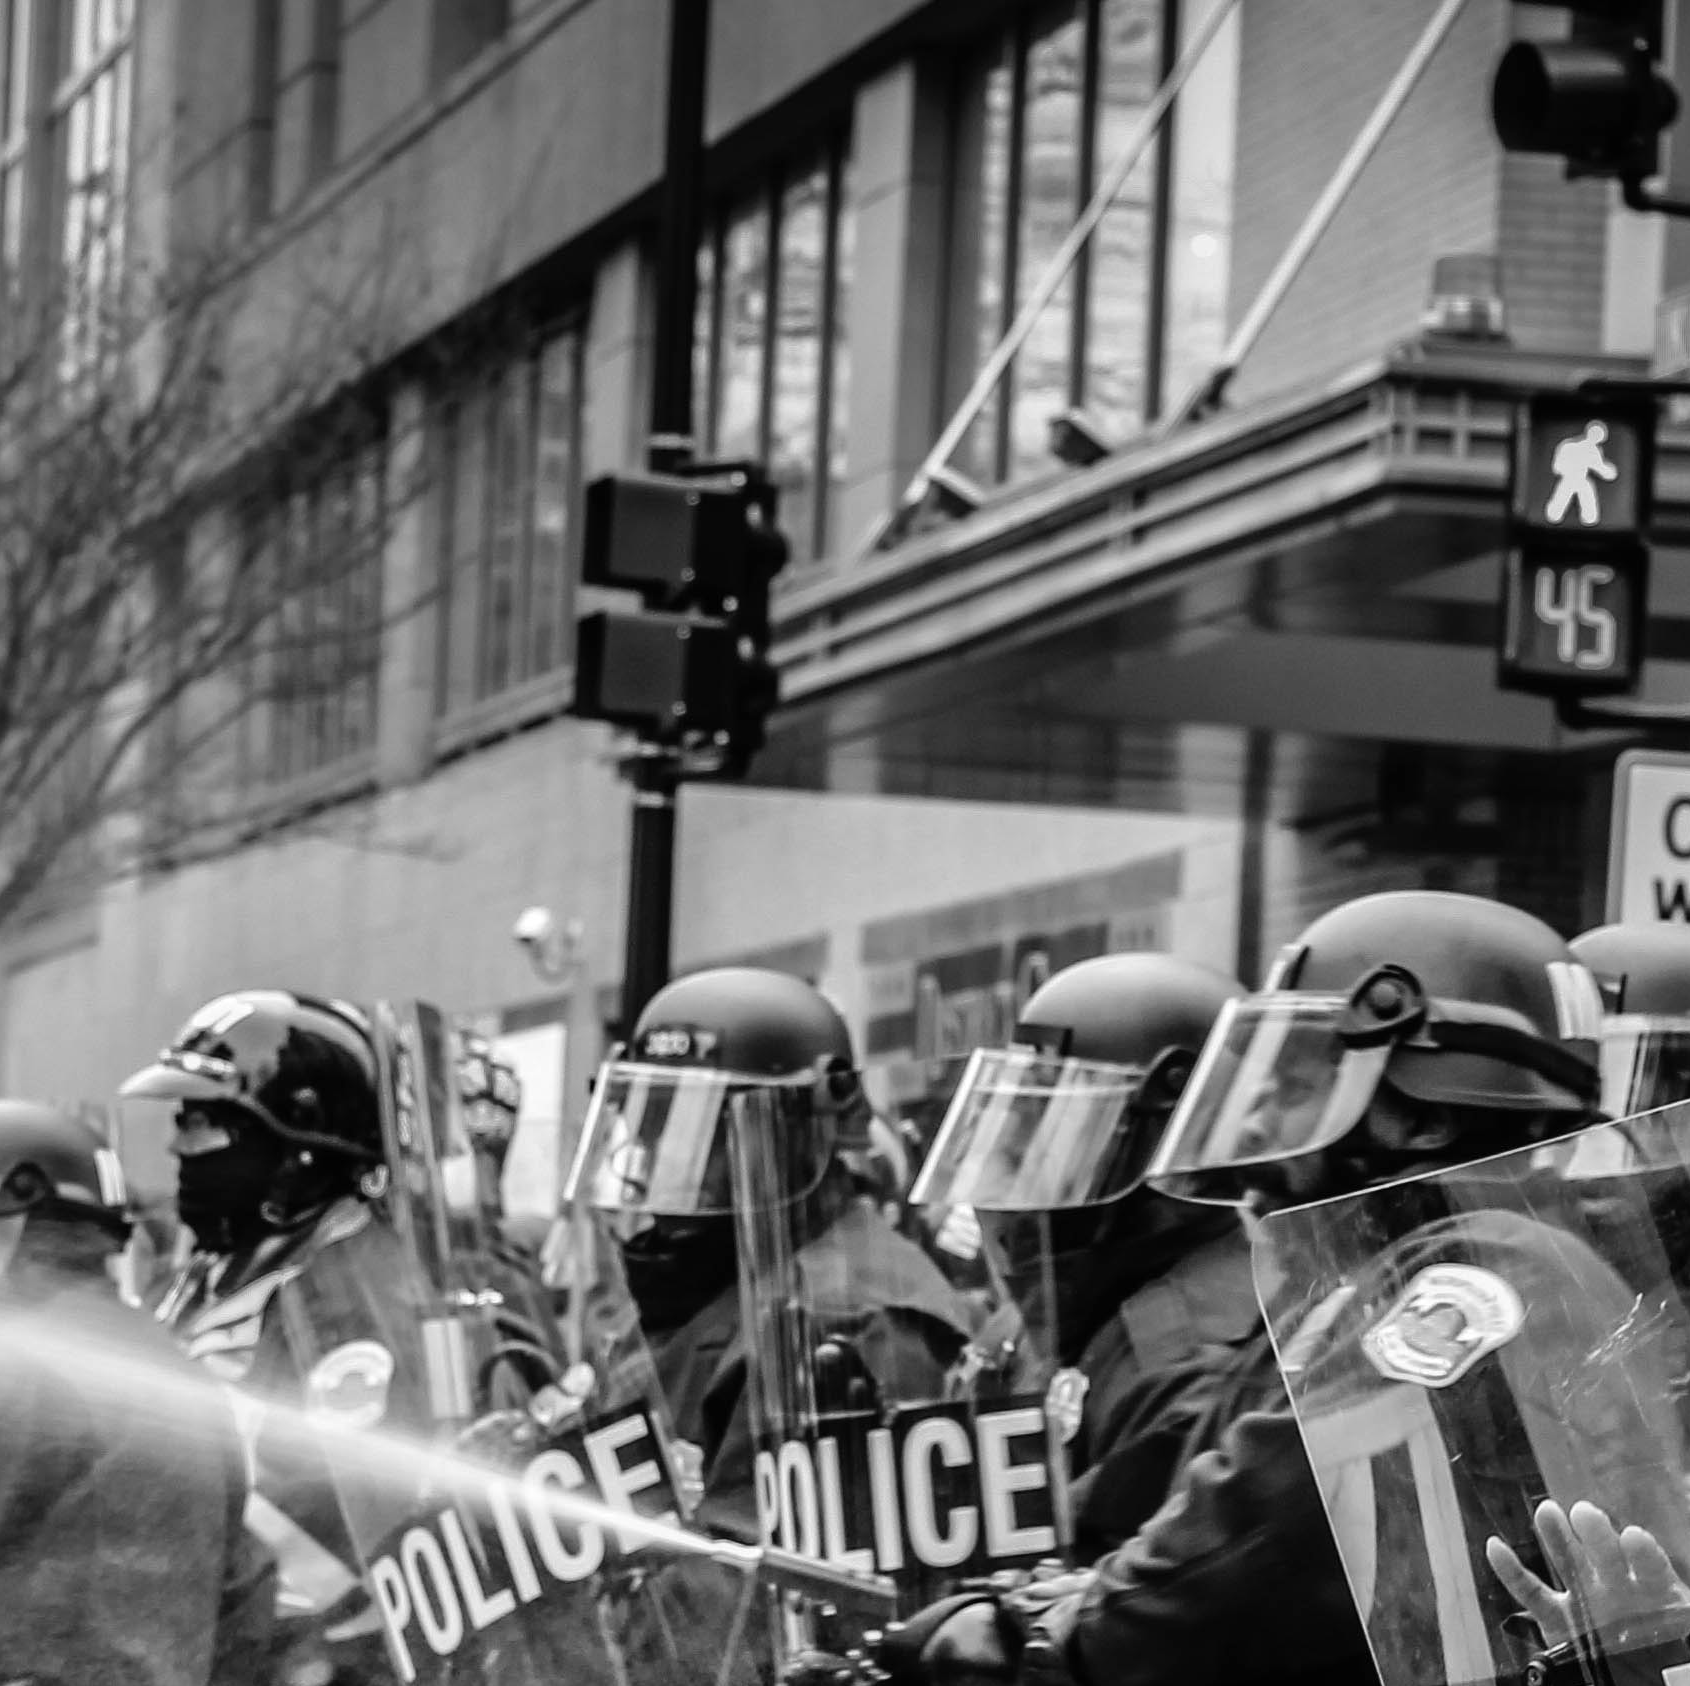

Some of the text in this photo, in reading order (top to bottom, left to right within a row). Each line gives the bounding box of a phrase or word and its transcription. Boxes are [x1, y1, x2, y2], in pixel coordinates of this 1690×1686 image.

[1535, 564, 1617, 670] 45
[370, 1413, 685, 1683] POLICE
[754, 1407, 1057, 1573] POLICE
